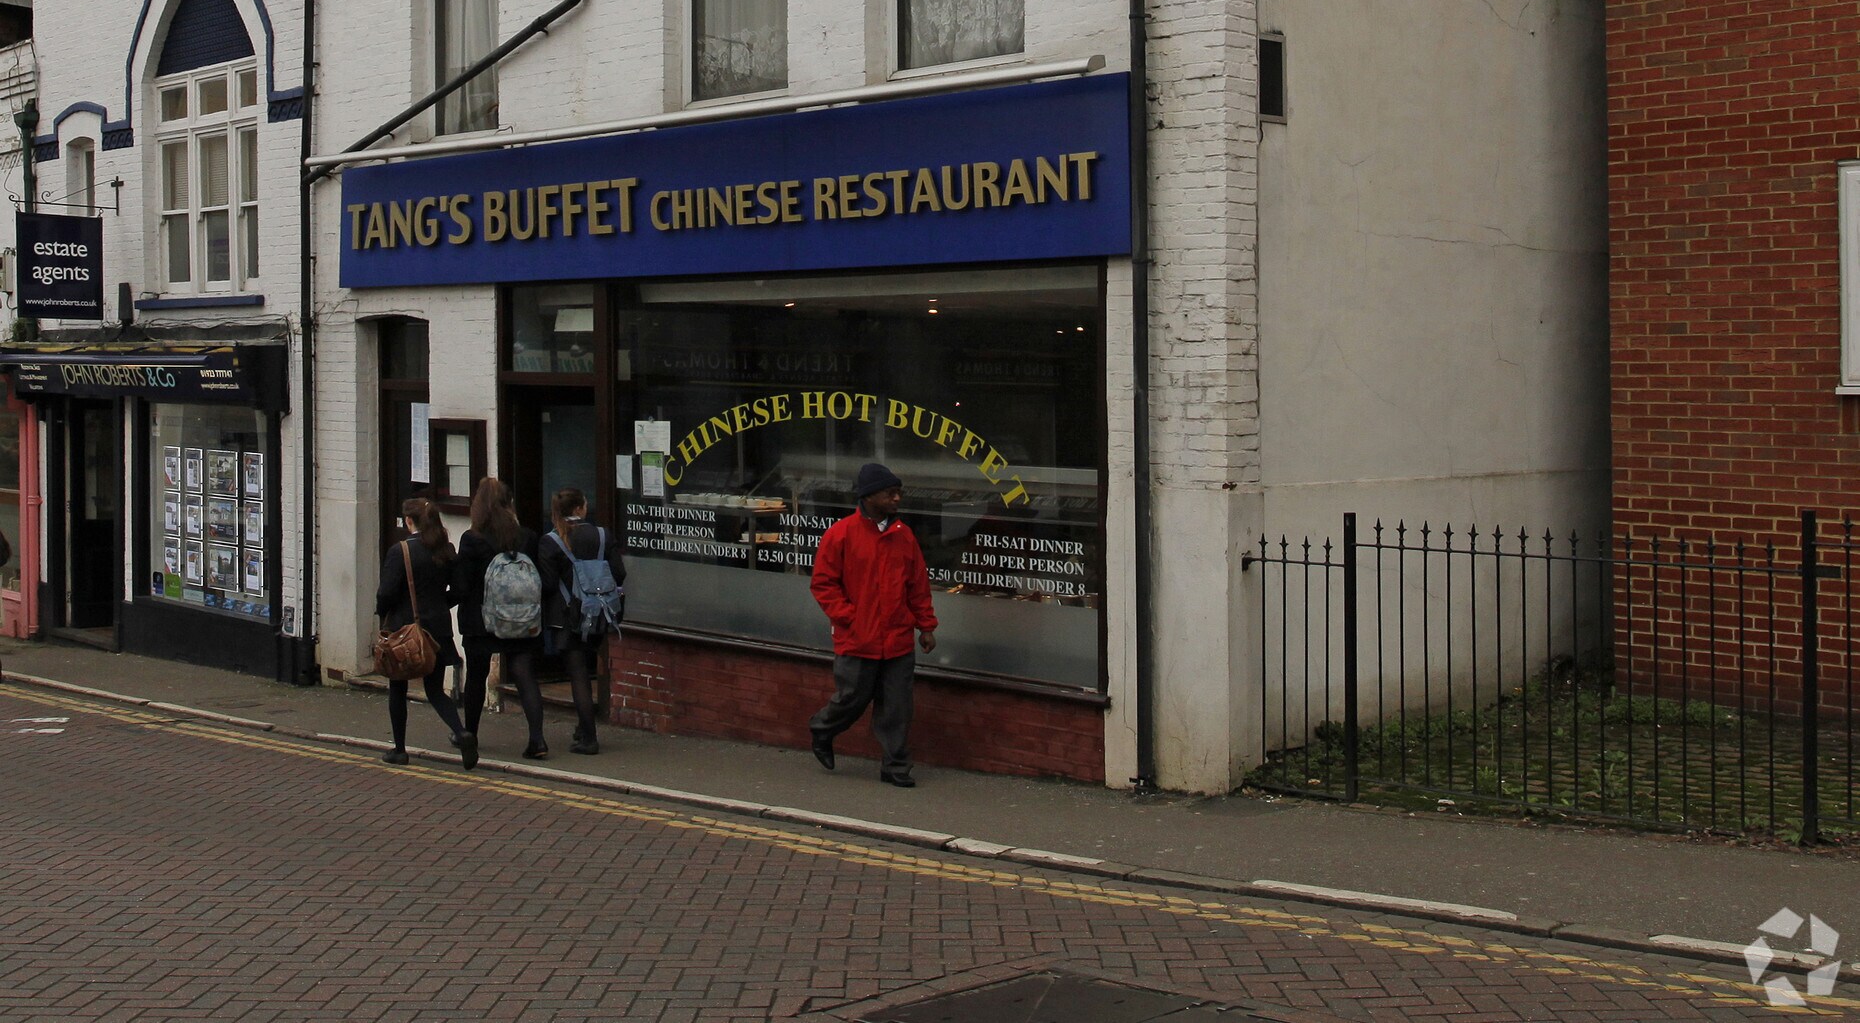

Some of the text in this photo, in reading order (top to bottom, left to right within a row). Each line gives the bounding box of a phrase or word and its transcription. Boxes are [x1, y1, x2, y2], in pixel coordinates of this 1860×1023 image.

[347, 150, 1098, 251] TANG'S BUFFET CHINESE RESTAURANT
[33, 241, 88, 257] estate
[32, 265, 90, 285] agents
[25, 298, 97, 307] www.johnroberts.co.uk
[60, 364, 95, 390] JOHN
[92, 365, 147, 387] ROBERTS
[664, 393, 793, 487] CHINESE
[800, 391, 877, 423] HOT
[884, 398, 1031, 509] BUFFET
[626, 503, 716, 522] SUN-THUR DINNER
[779, 513, 835, 530] MON-SAT
[626, 520, 715, 539] £10.50 PER PERSON
[778, 532, 805, 547] £5.50
[627, 536, 747, 560] £5.50 CHILDREN UNDER 8
[975, 533, 1084, 556] FRI-SAT DINNER
[757, 548, 815, 567] £3.50 CHIL
[961, 551, 1085, 576] £11.90 PER PERSON
[926, 567, 1086, 597] 5.50 CHILDREN UNDER 8
